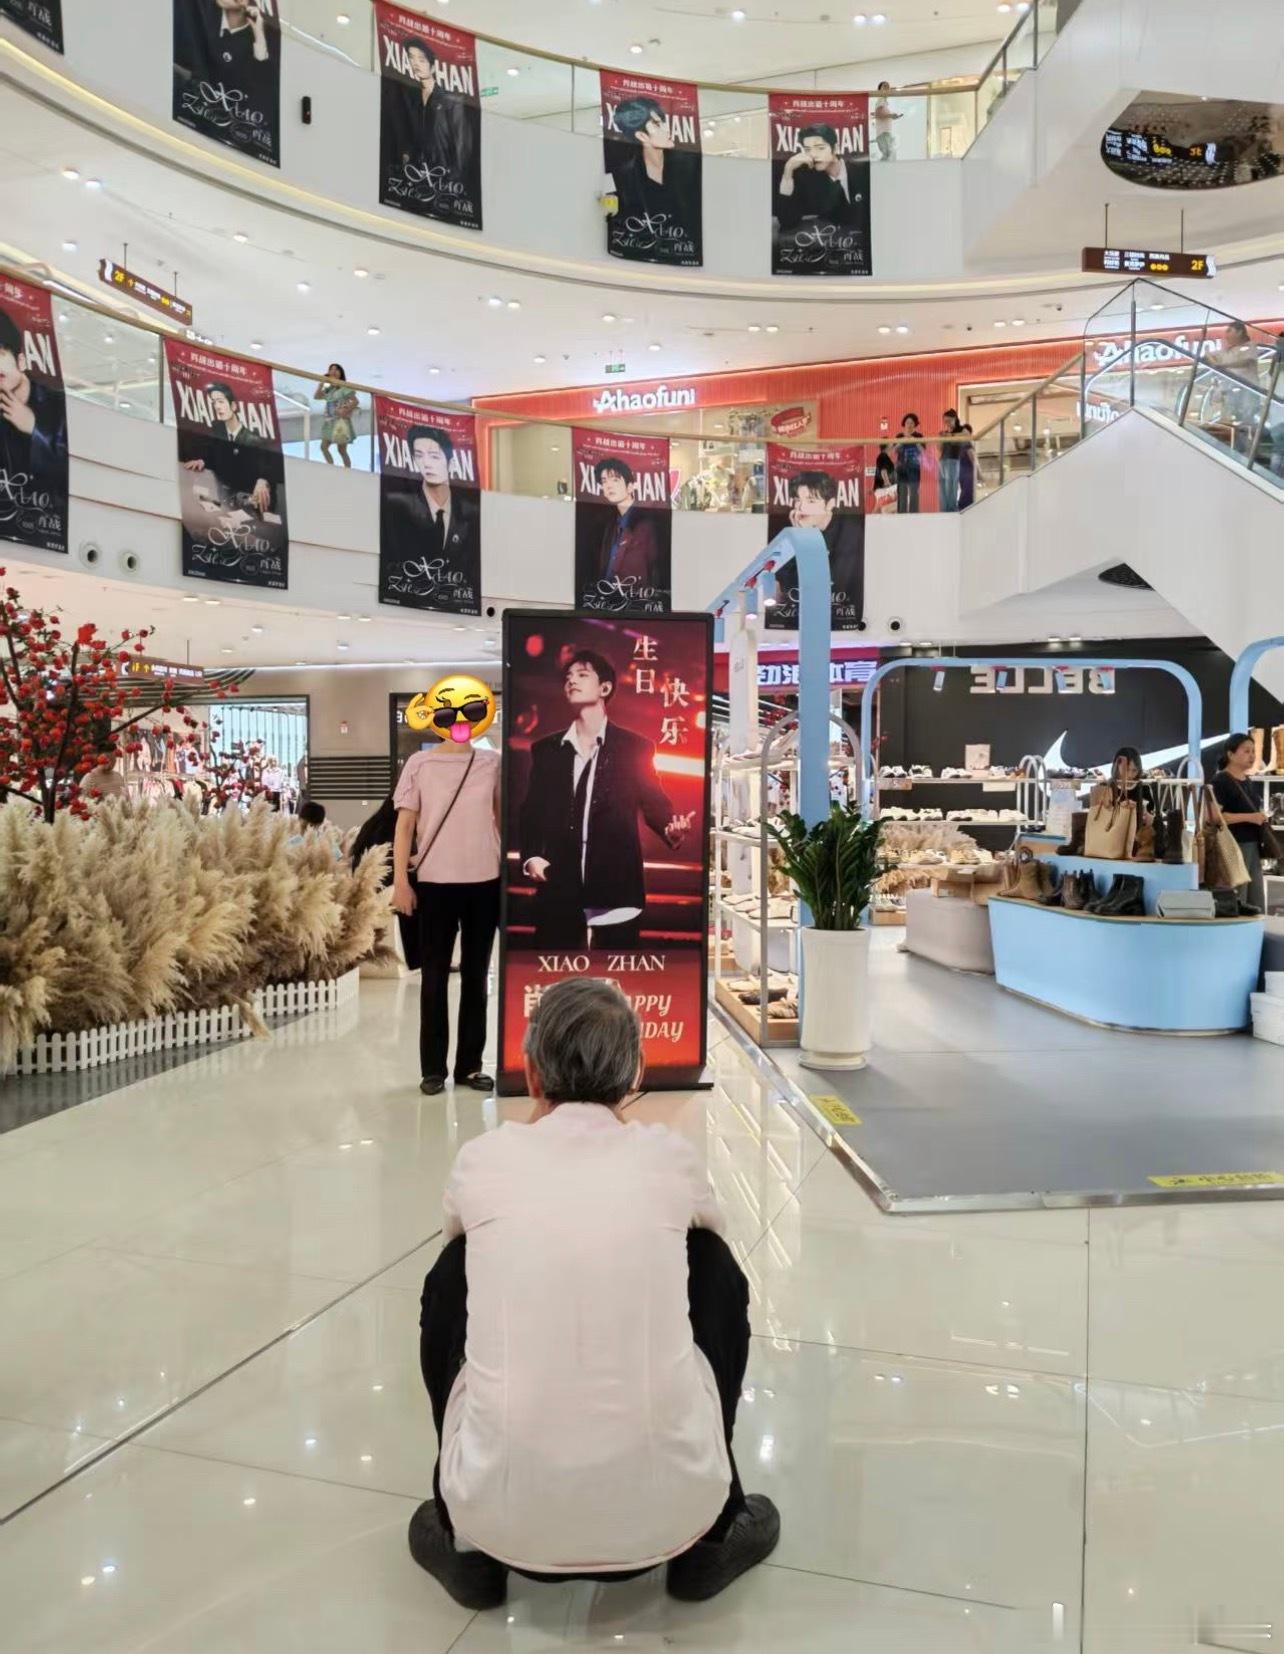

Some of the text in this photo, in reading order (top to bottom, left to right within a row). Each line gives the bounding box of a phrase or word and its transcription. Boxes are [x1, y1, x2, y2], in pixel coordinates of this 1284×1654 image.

[383, 34, 475, 97] XIA HAN
[775, 123, 806, 154] XIA
[1191, 260, 1205, 271] 2F
[24, 329, 57, 378] AN
[382, 431, 475, 482] XIA AN
[836, 477, 860, 509] AN
[633, 635, 659, 694] 生日
[659, 677, 690, 745] 快乐
[537, 954, 666, 972] XIAO ZHAN
